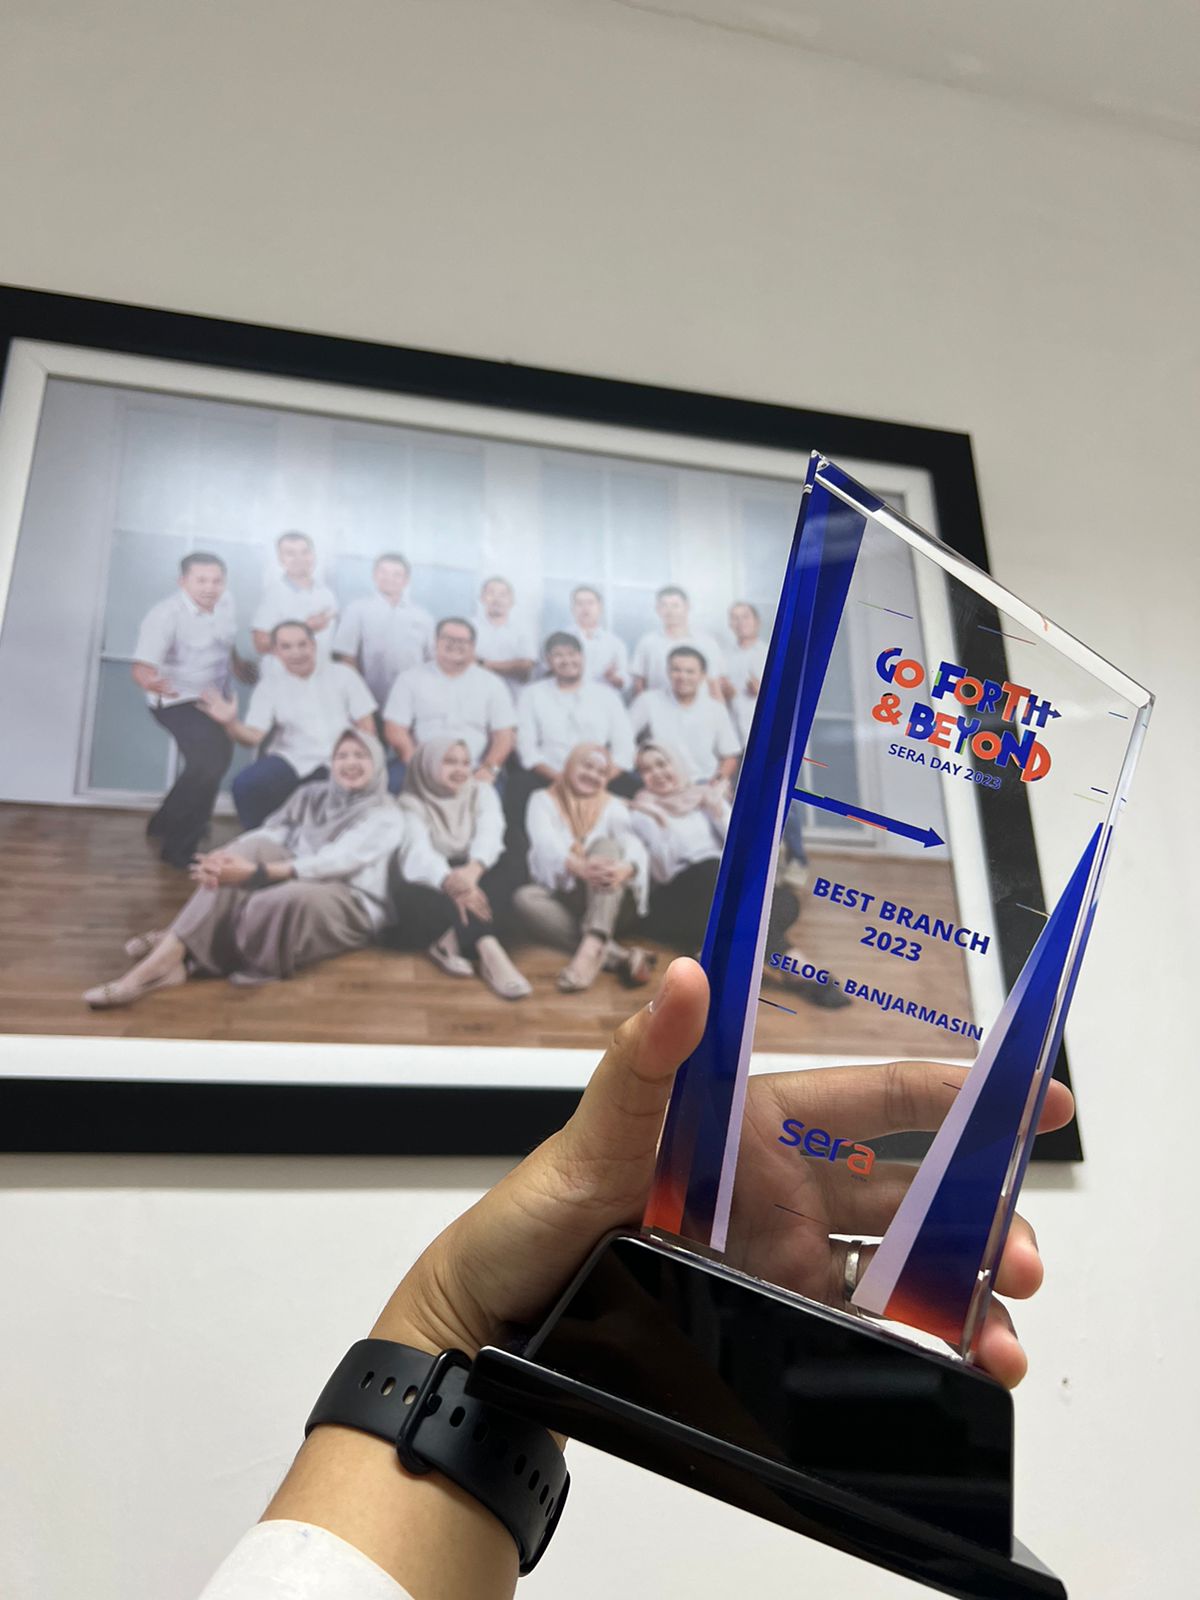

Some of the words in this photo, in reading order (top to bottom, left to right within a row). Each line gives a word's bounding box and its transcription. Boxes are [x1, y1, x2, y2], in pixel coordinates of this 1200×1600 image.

[876, 647, 925, 689] GO
[931, 661, 1053, 728] FORTH
[872, 693, 903, 725] &
[905, 702, 1052, 782] BEYOND
[888, 743, 926, 765] SERA
[930, 757, 962, 776] DAY
[964, 768, 1001, 790] 2023
[813, 877, 875, 912] BEST
[879, 901, 991, 955] BRANCH
[860, 926, 923, 962] 2023
[769, 953, 830, 984] SELOG
[844, 979, 984, 1041] BANJARMASIN
[778, 1118, 875, 1175] sera
